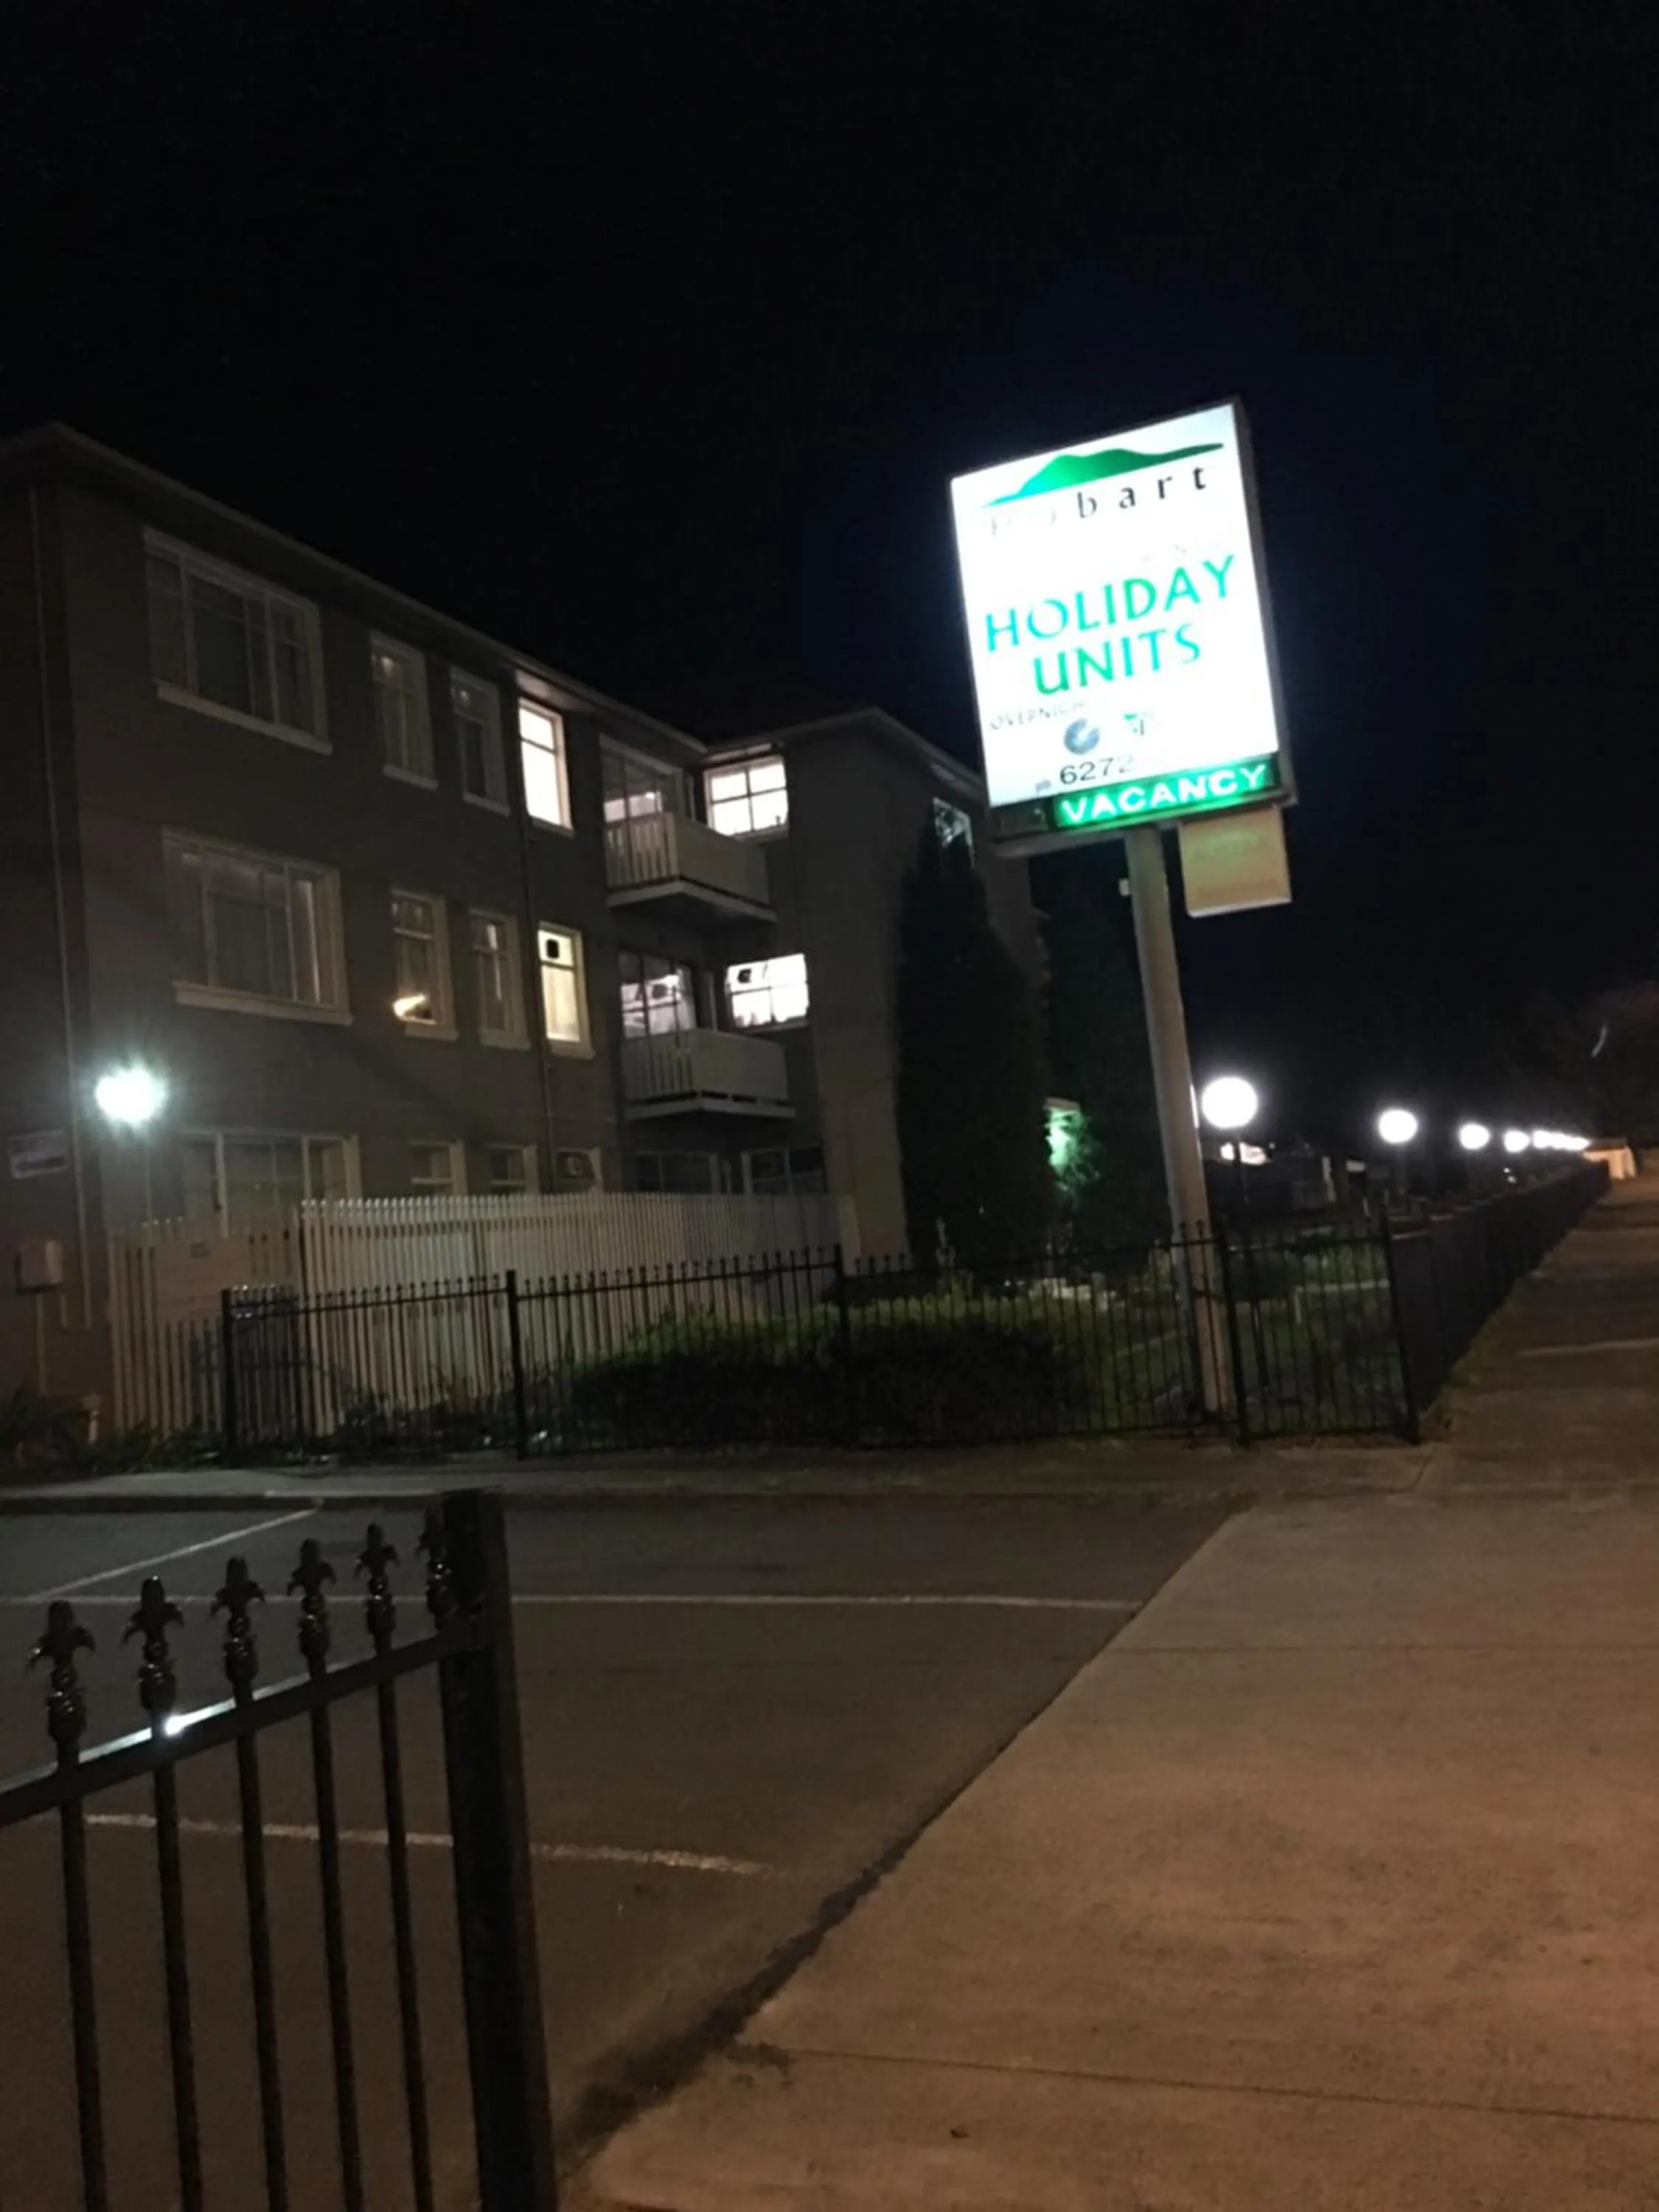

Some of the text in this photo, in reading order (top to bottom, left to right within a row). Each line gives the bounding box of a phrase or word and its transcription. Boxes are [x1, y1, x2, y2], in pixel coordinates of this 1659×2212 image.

[990, 465, 1208, 538] bart
[985, 554, 1235, 653] HOLIDAY
[1033, 623, 1201, 695] UNITS
[1062, 764, 1267, 823] VACANCY
